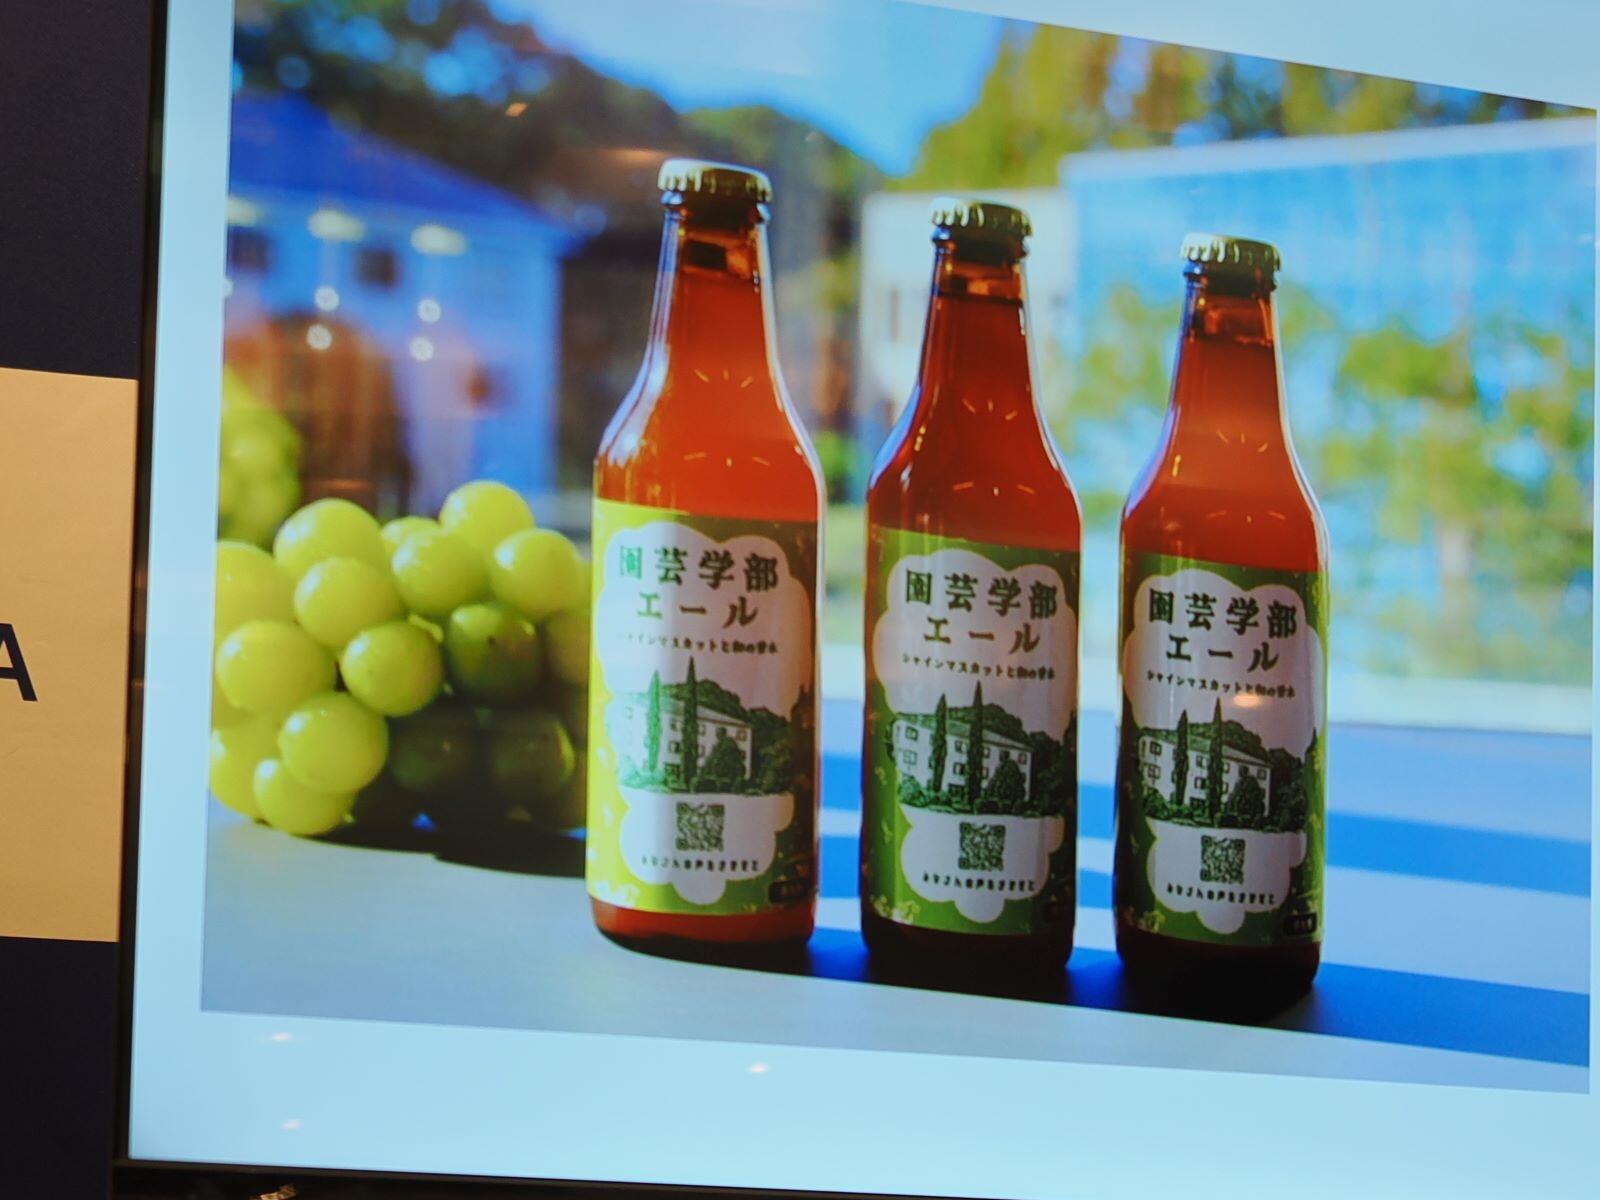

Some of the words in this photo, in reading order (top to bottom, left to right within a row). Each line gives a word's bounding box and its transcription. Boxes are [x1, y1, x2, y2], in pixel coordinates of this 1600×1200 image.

[619, 545, 779, 592] 園芸学部
[637, 592, 758, 629] エール
[906, 569, 1058, 620] 園芸学部
[1149, 588, 1298, 639] 園芸学部
[924, 616, 1040, 654] エール
[1166, 634, 1280, 673] エール
